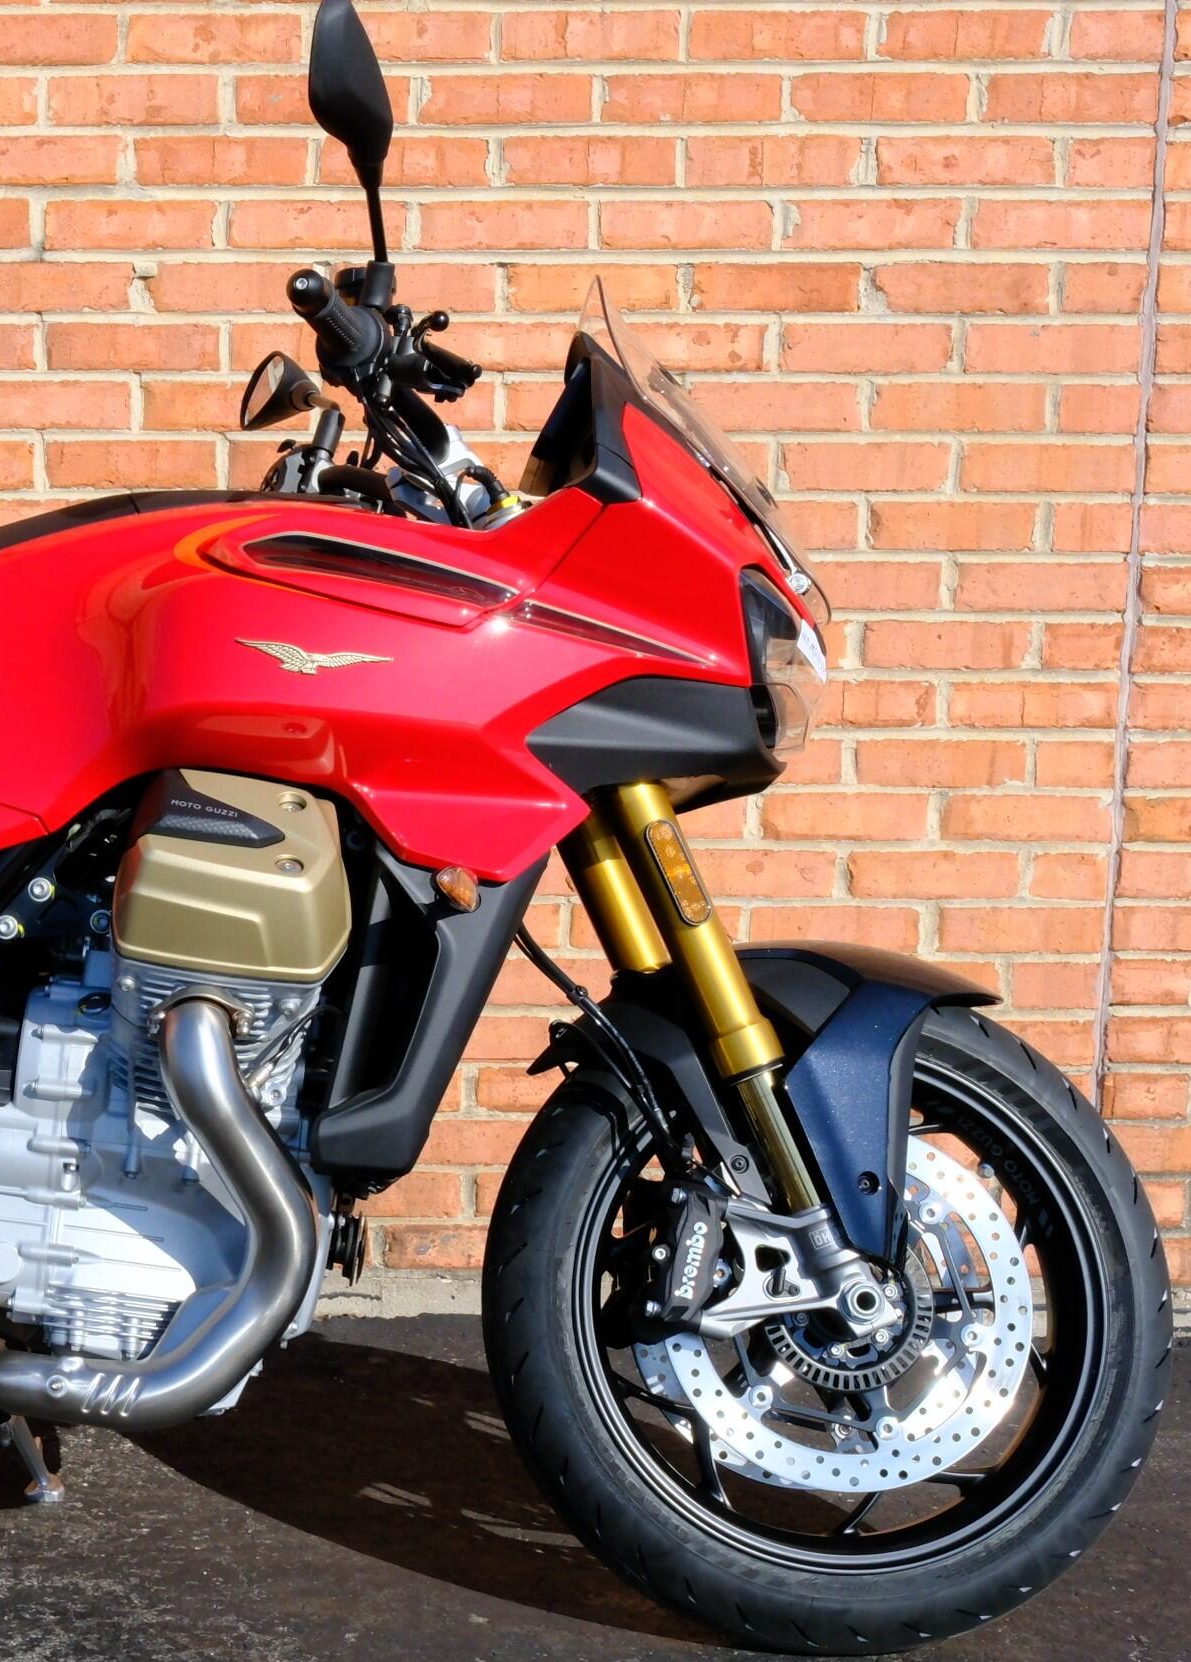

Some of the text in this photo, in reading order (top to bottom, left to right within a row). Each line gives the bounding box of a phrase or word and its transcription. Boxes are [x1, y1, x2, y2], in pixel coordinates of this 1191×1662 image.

[170, 799, 239, 818] MOTO GUZZI
[1003, 1159, 1041, 1206] MOTO
[674, 1221, 708, 1300] brembo
